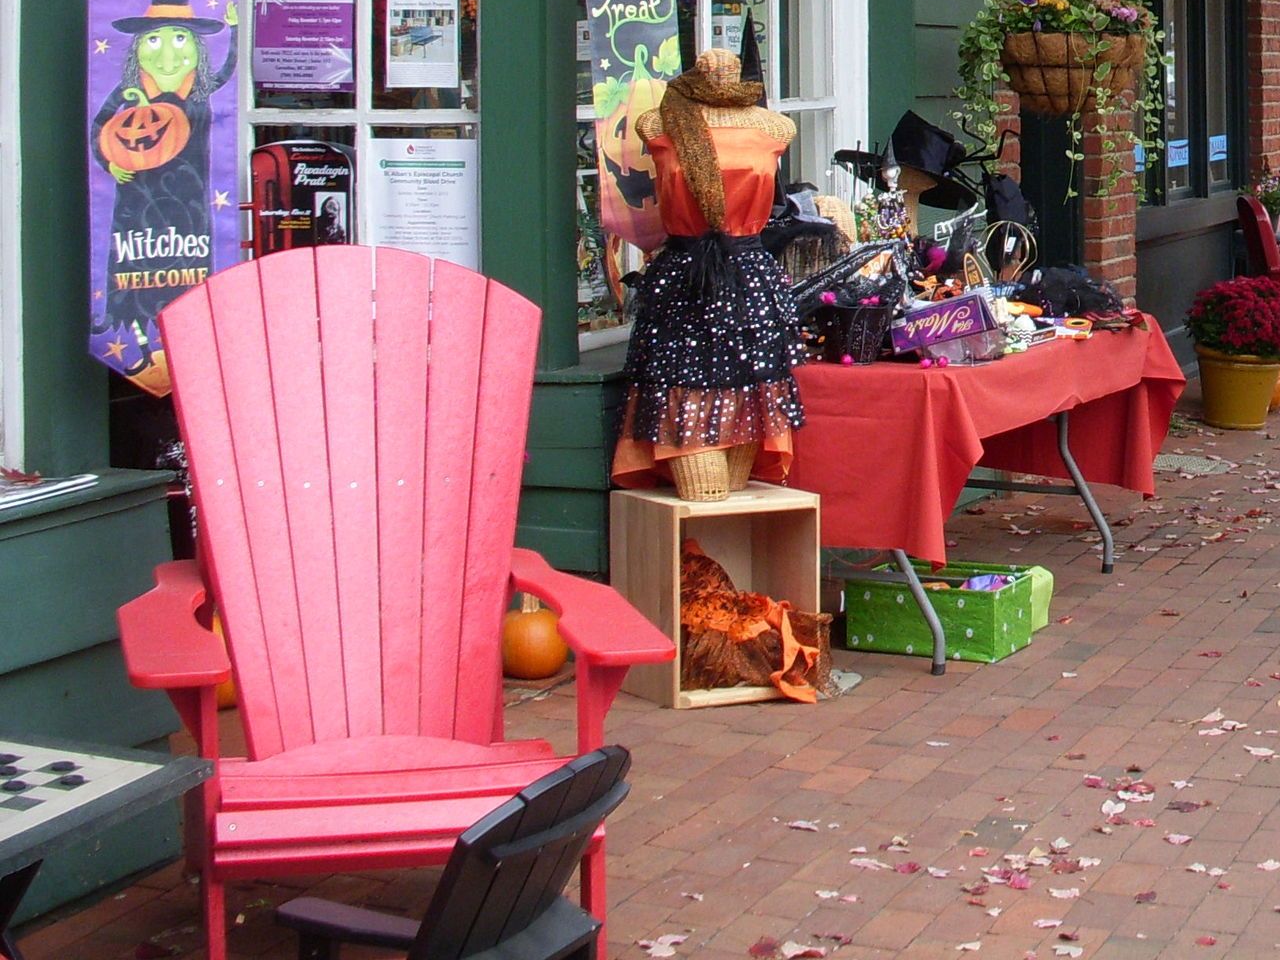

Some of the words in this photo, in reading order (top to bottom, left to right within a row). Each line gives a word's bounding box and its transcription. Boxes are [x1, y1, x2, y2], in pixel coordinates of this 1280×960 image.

[294, 162, 349, 179] Awadagin
[294, 174, 327, 186] Pratt
[112, 226, 210, 264] Witches
[115, 267, 209, 291] WELCOME
